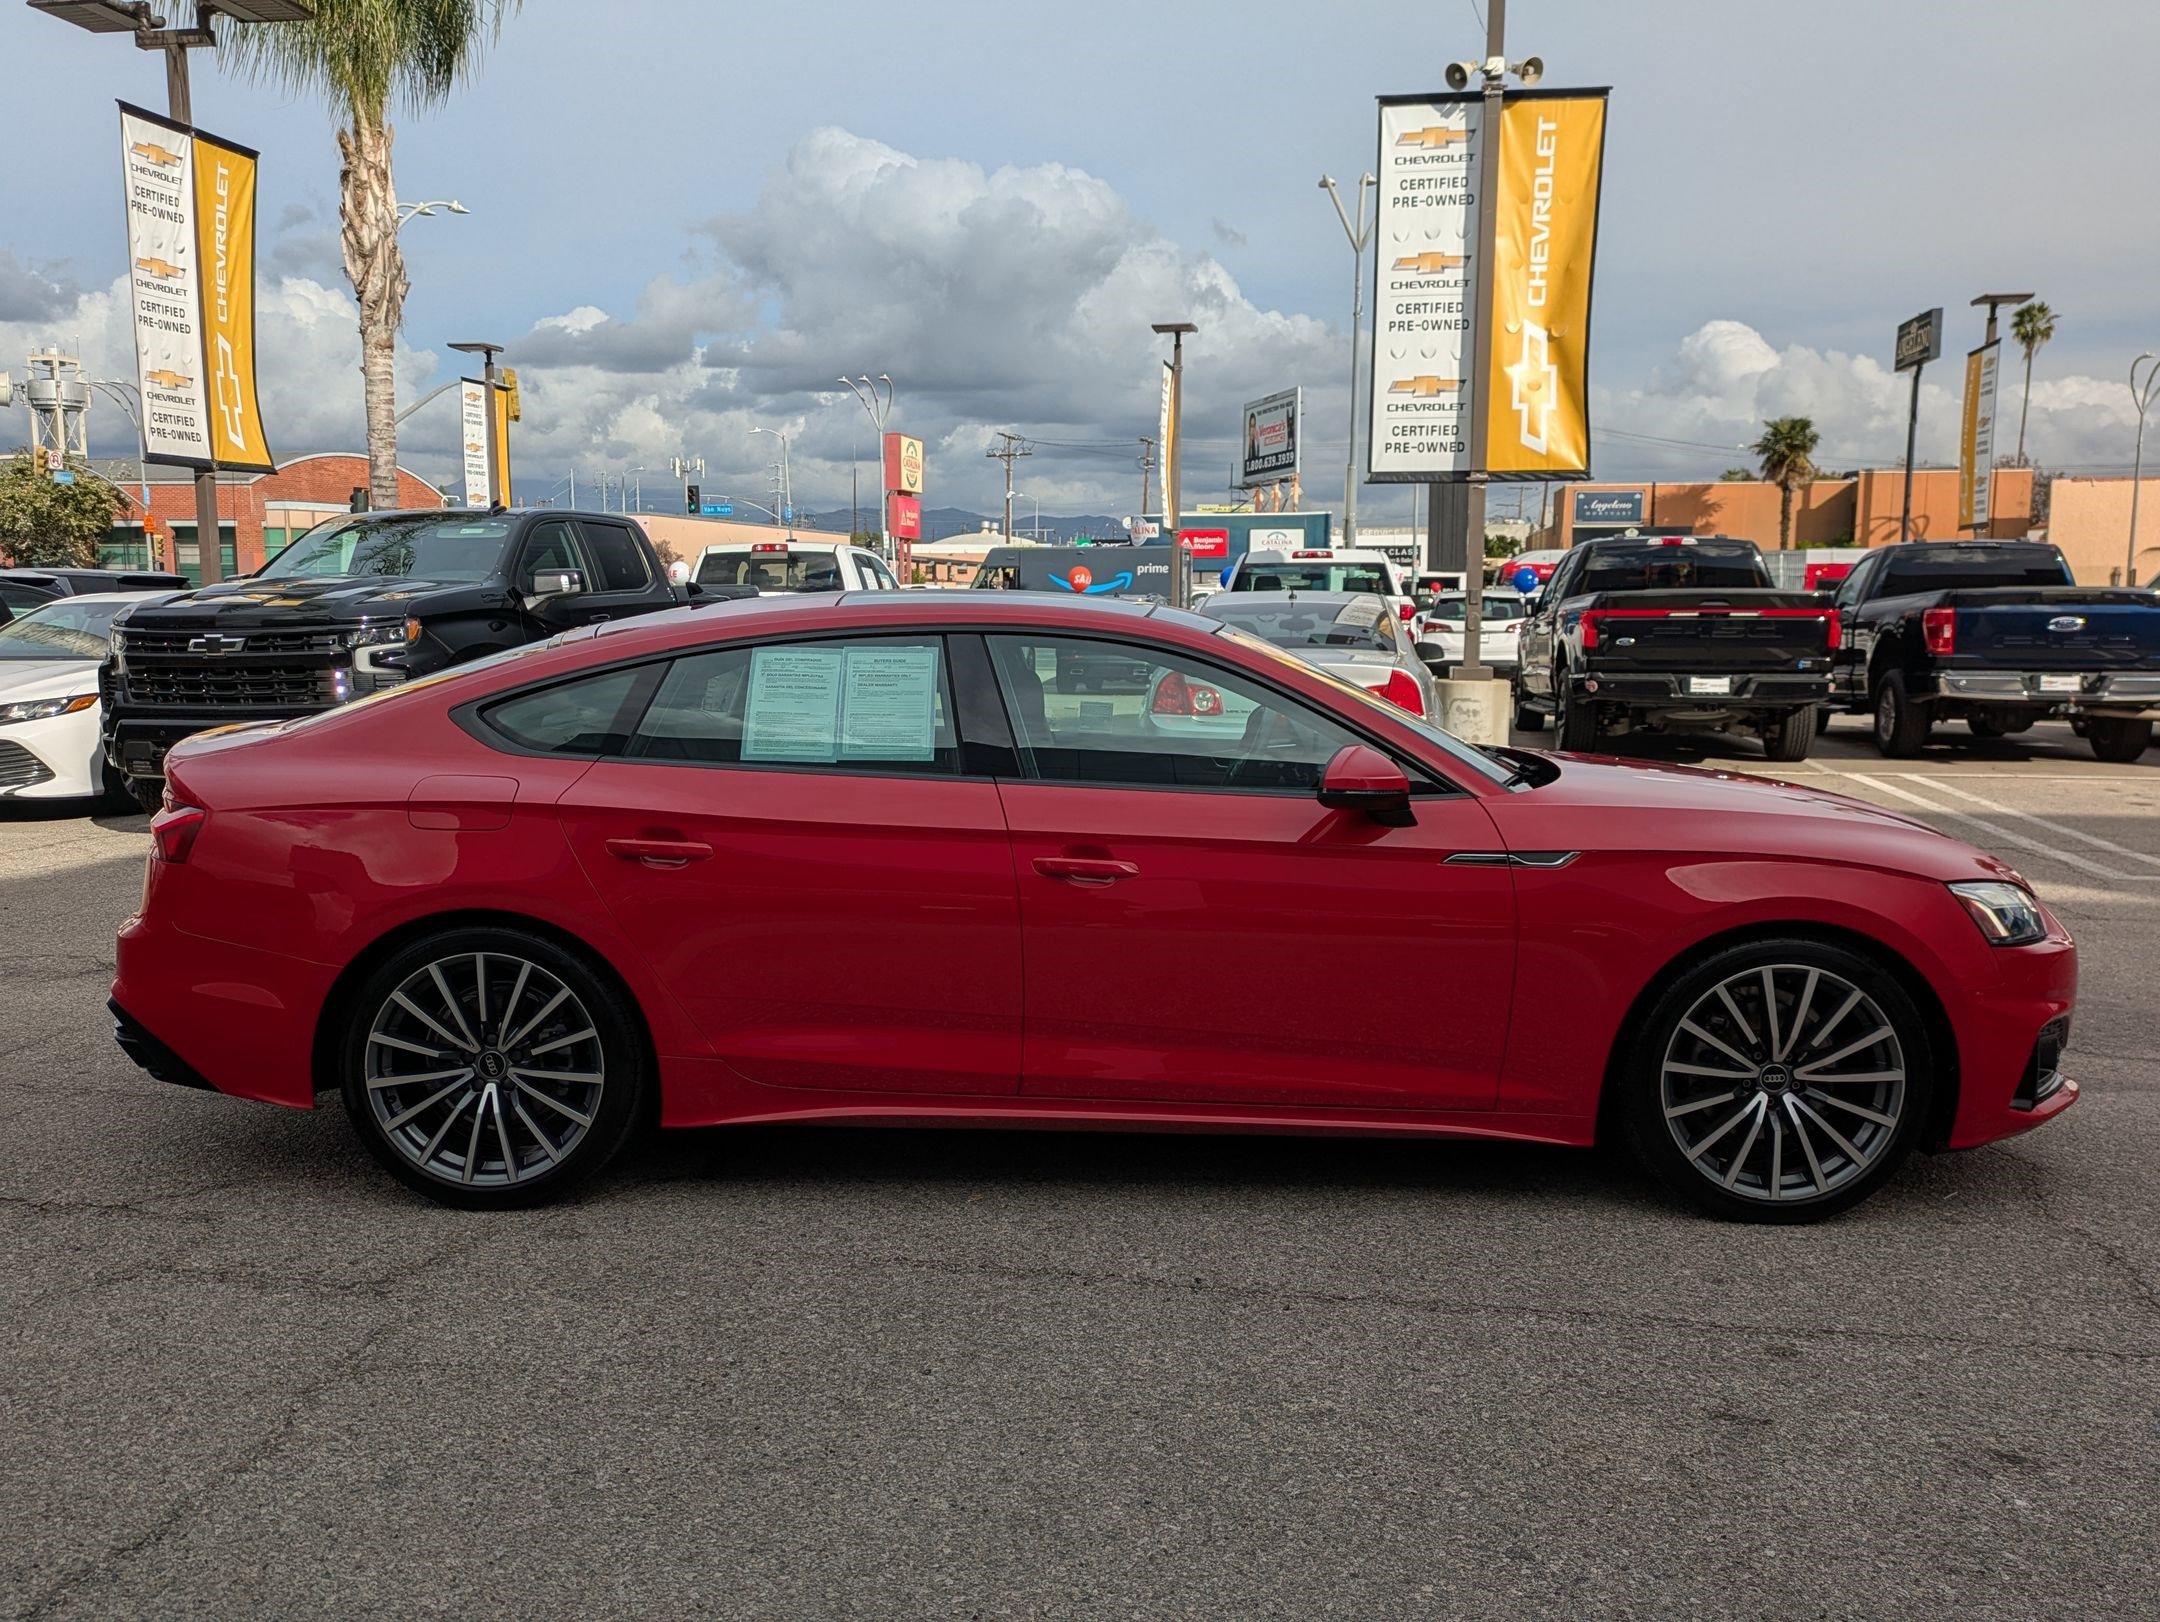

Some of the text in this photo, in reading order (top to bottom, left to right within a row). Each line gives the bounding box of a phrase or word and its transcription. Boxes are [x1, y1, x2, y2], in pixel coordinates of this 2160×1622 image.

[1395, 152, 1476, 166] CHEVROLET
[131, 163, 183, 186] CHEVROLET
[1400, 176, 1470, 191] CERTIFIED
[134, 185, 180, 208] CERTIFIED
[1392, 193, 1475, 208] PRE-OWNED
[131, 200, 185, 224] PRE-OWNED
[1527, 115, 1558, 308] CHEVROLET
[215, 161, 230, 324] CHEVROLET
[136, 278, 188, 297] CHEVROLET
[1390, 278, 1472, 291] CHEVROLET
[140, 300, 186, 319] CERTIFIED
[1395, 302, 1465, 316] CERTIFIED
[138, 314, 191, 335] PRE-OWNED
[1388, 317, 1470, 333] PRE-OWNED
[147, 391, 197, 406] CHEVROLET
[1386, 401, 1467, 413] CHEVROLET
[152, 411, 196, 427] CERTIFIED
[150, 427, 202, 443] PRE-OWNED
[1391, 424, 1460, 439] CERTIFIED
[1384, 441, 1466, 455] PRE-OWNED
[1246, 451, 1295, 472] 1.800.639.3939
[717, 506, 732, 514] Nuys
[1193, 536, 1224, 544] Benjamin
[1136, 563, 1169, 576] prime
